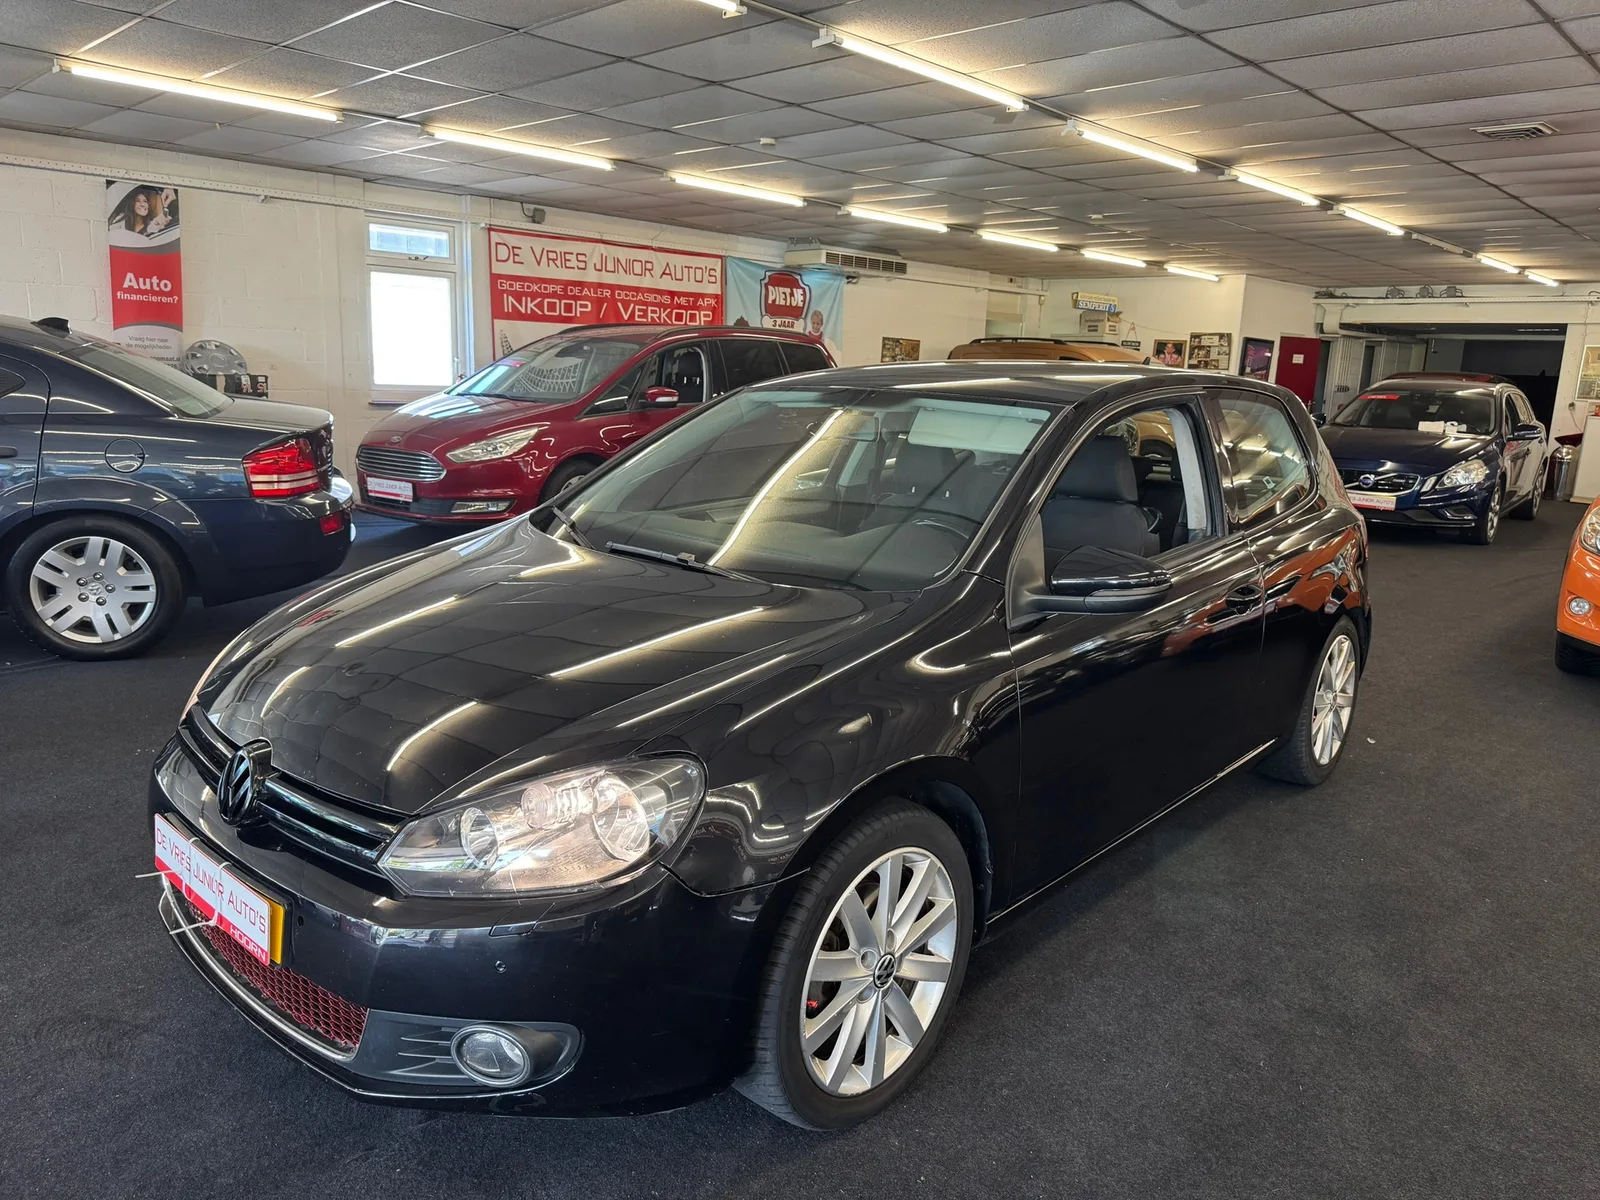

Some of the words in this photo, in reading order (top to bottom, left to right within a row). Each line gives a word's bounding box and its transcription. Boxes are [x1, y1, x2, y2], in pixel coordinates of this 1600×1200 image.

[495, 241, 524, 265] DE
[530, 245, 587, 271] VRIES
[593, 253, 654, 278] JUNIOR
[660, 261, 717, 284] AUTO'S
[122, 272, 172, 292] Auto
[497, 280, 564, 294] GOEDKOPE
[567, 286, 611, 299] DEALER
[615, 290, 671, 304] OCCASIONS
[674, 295, 695, 306] MET
[697, 298, 718, 308] APK
[116, 291, 179, 304] financieren?
[767, 285, 804, 307] PIETJE
[503, 293, 592, 317] INKOOP
[617, 302, 712, 326] VERKOOP
[772, 319, 778, 328] 3
[778, 320, 796, 329] JAAR
[128, 335, 145, 343] Vraag
[156, 828, 167, 850] DE
[169, 837, 191, 872] VRIES
[193, 866, 225, 899] JUNIOR
[227, 890, 266, 934] AUTO'S
[230, 924, 266, 962] HOORN
